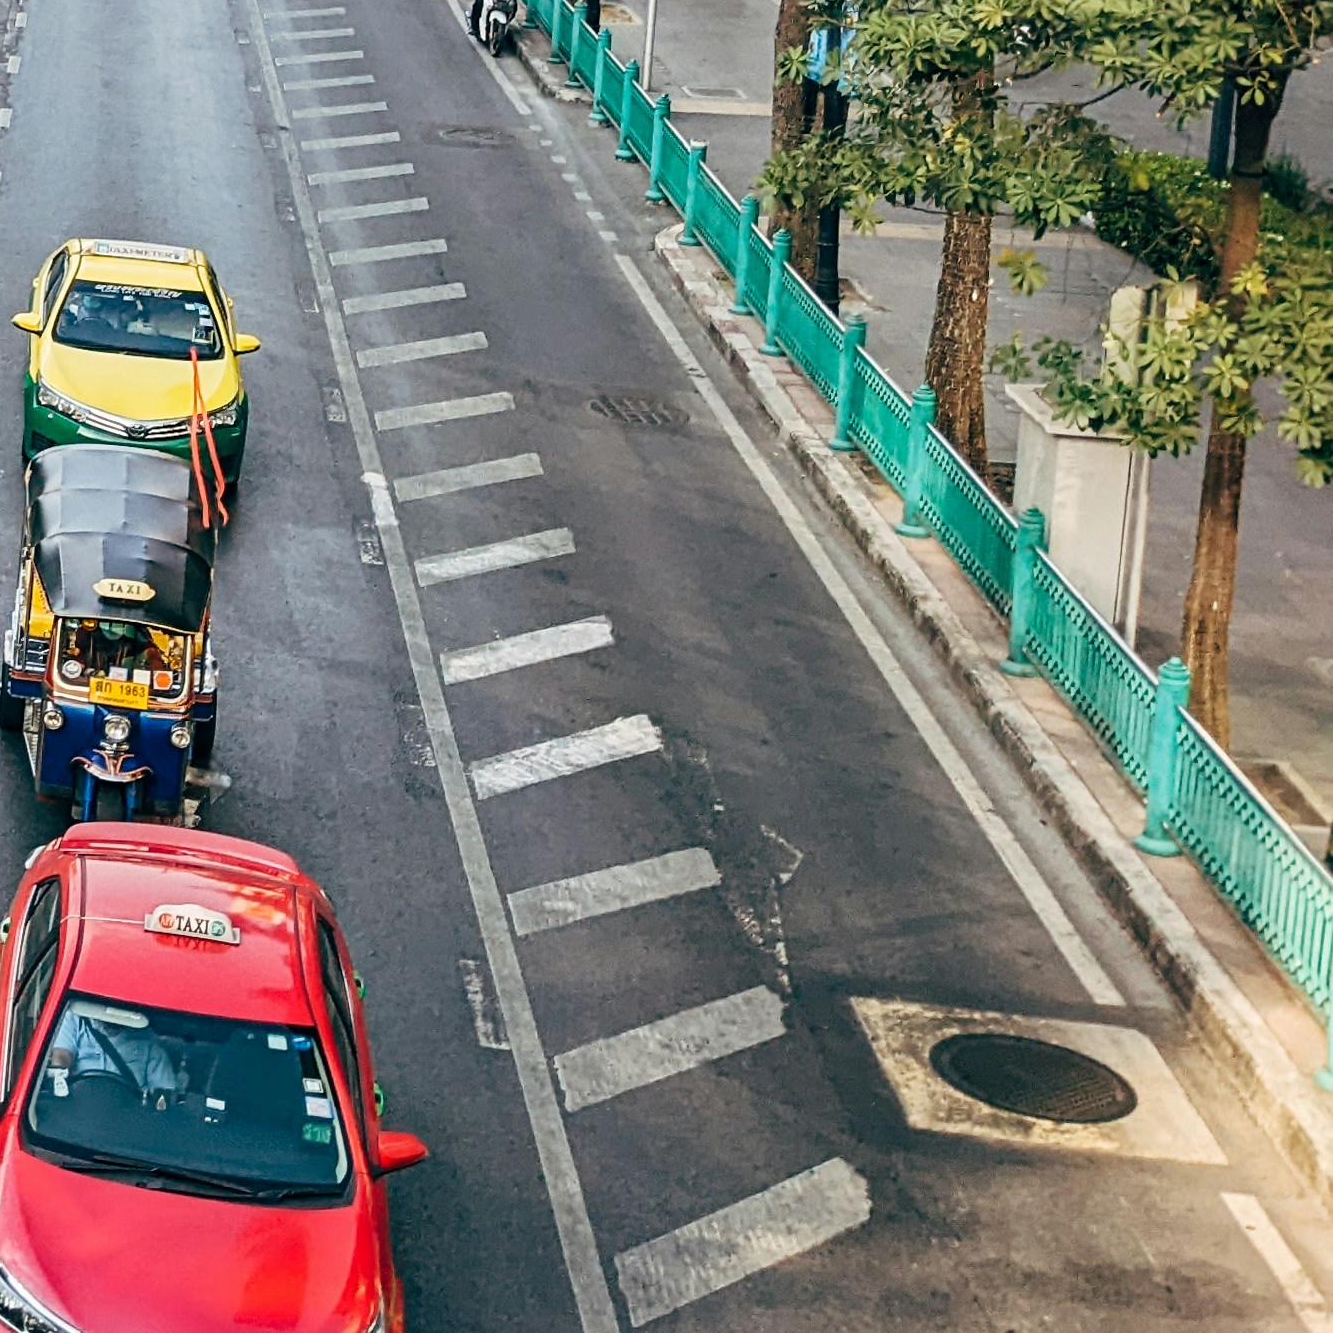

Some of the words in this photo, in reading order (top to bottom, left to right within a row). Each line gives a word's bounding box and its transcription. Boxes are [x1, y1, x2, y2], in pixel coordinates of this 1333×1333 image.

[108, 582, 141, 595] TAXI
[119, 684, 146, 698] 1963
[175, 915, 210, 935] TAXI
